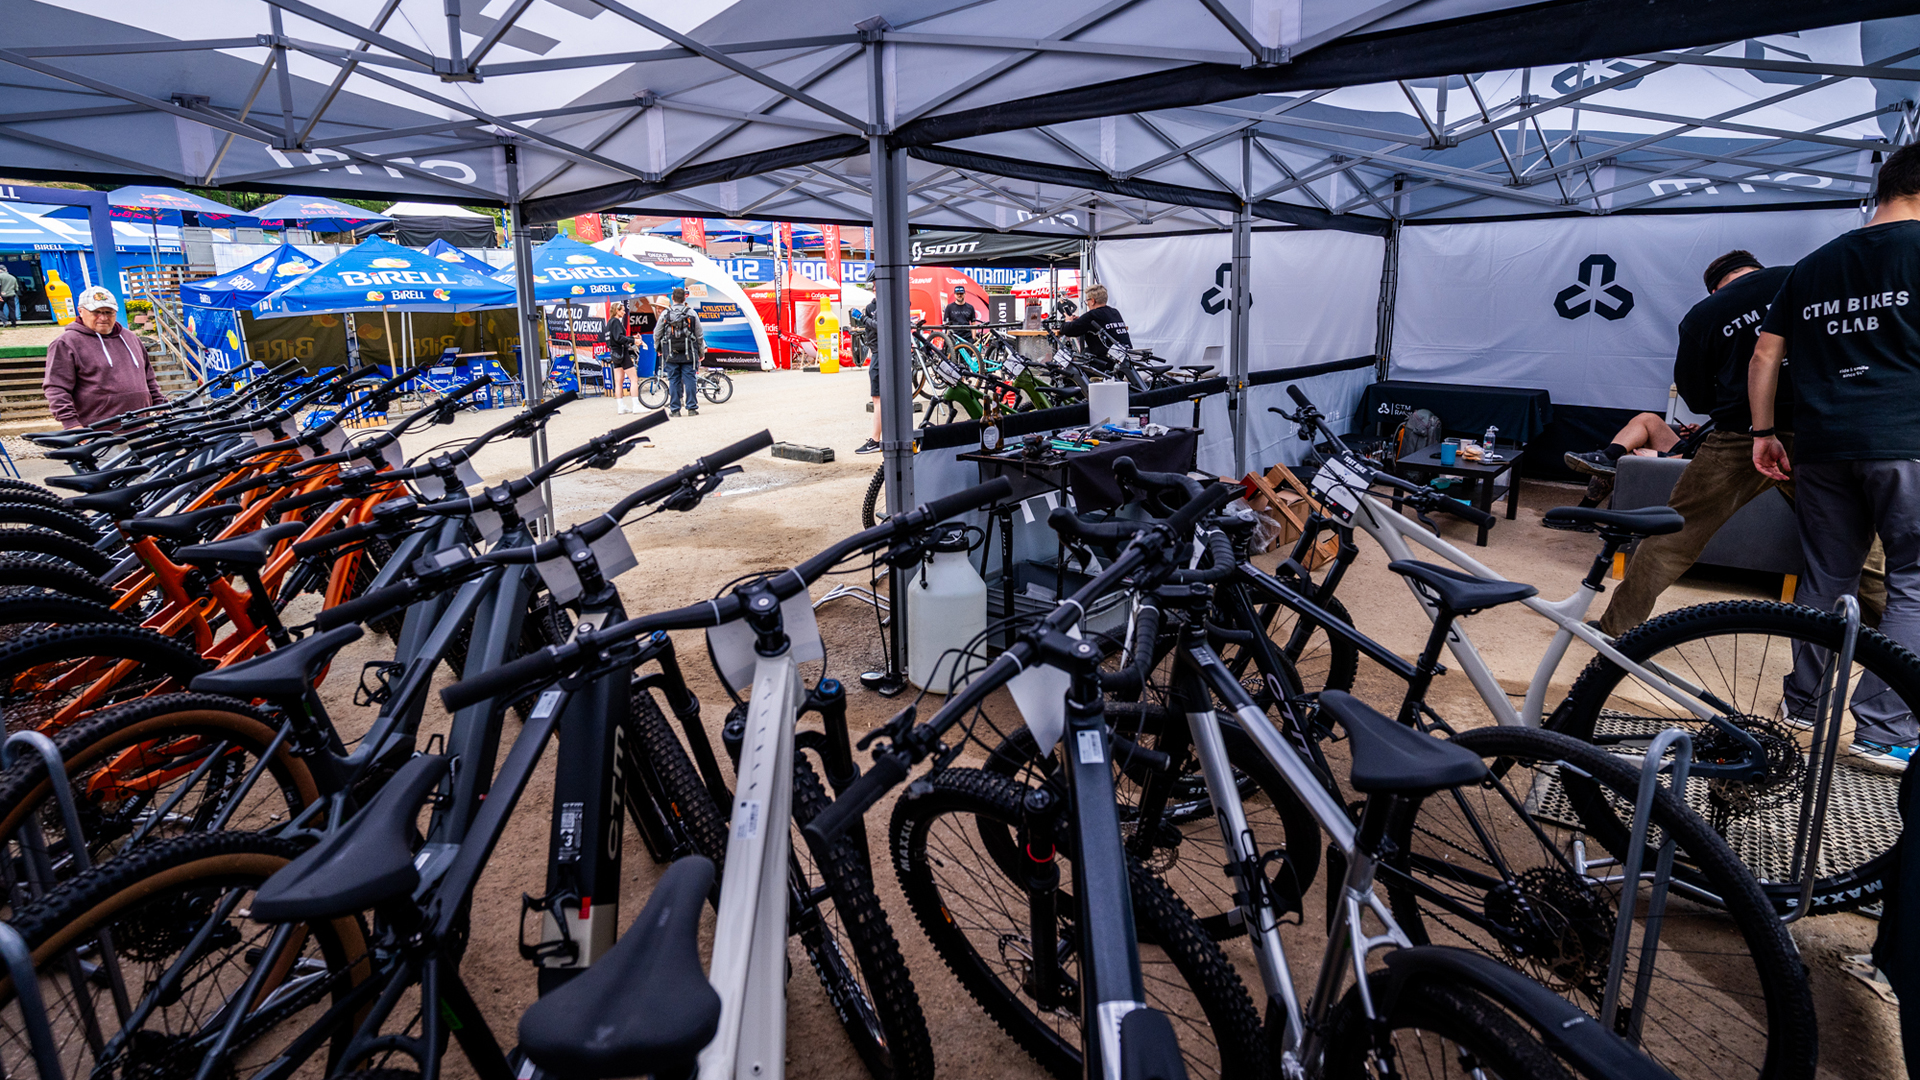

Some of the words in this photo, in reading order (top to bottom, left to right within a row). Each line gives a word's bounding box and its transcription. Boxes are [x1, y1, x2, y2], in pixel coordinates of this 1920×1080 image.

[923, 241, 980, 256] SCOTT
[1803, 299, 1841, 321] CTM
[1847, 290, 1910, 313] BIKES
[1722, 309, 1761, 338] CTM
[899, 819, 916, 872] MAXXIS
[1786, 879, 1884, 908] MAXXS
